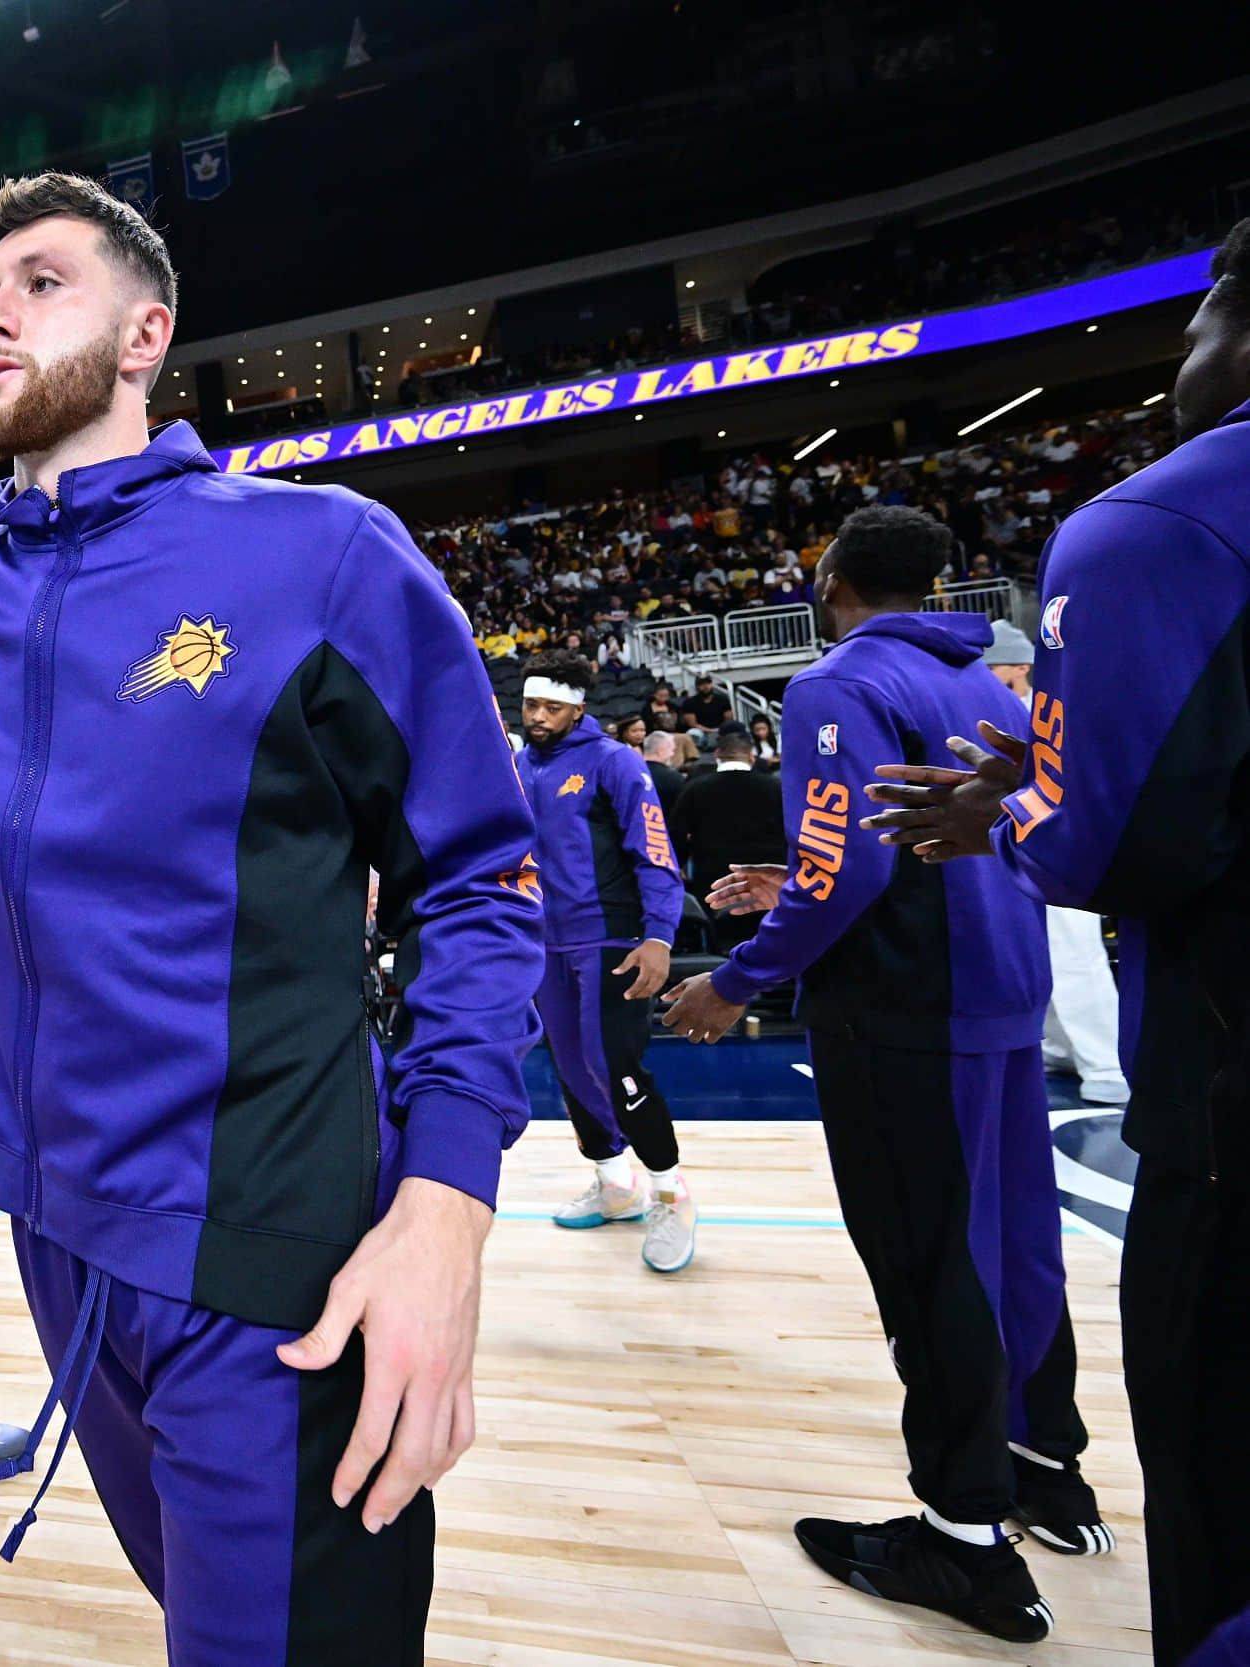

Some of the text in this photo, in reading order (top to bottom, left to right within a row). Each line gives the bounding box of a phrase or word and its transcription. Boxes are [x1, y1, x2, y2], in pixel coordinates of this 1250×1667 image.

[224, 321, 924, 474] LOS ANGELES LAKERS
[796, 779, 849, 901] SUNS
